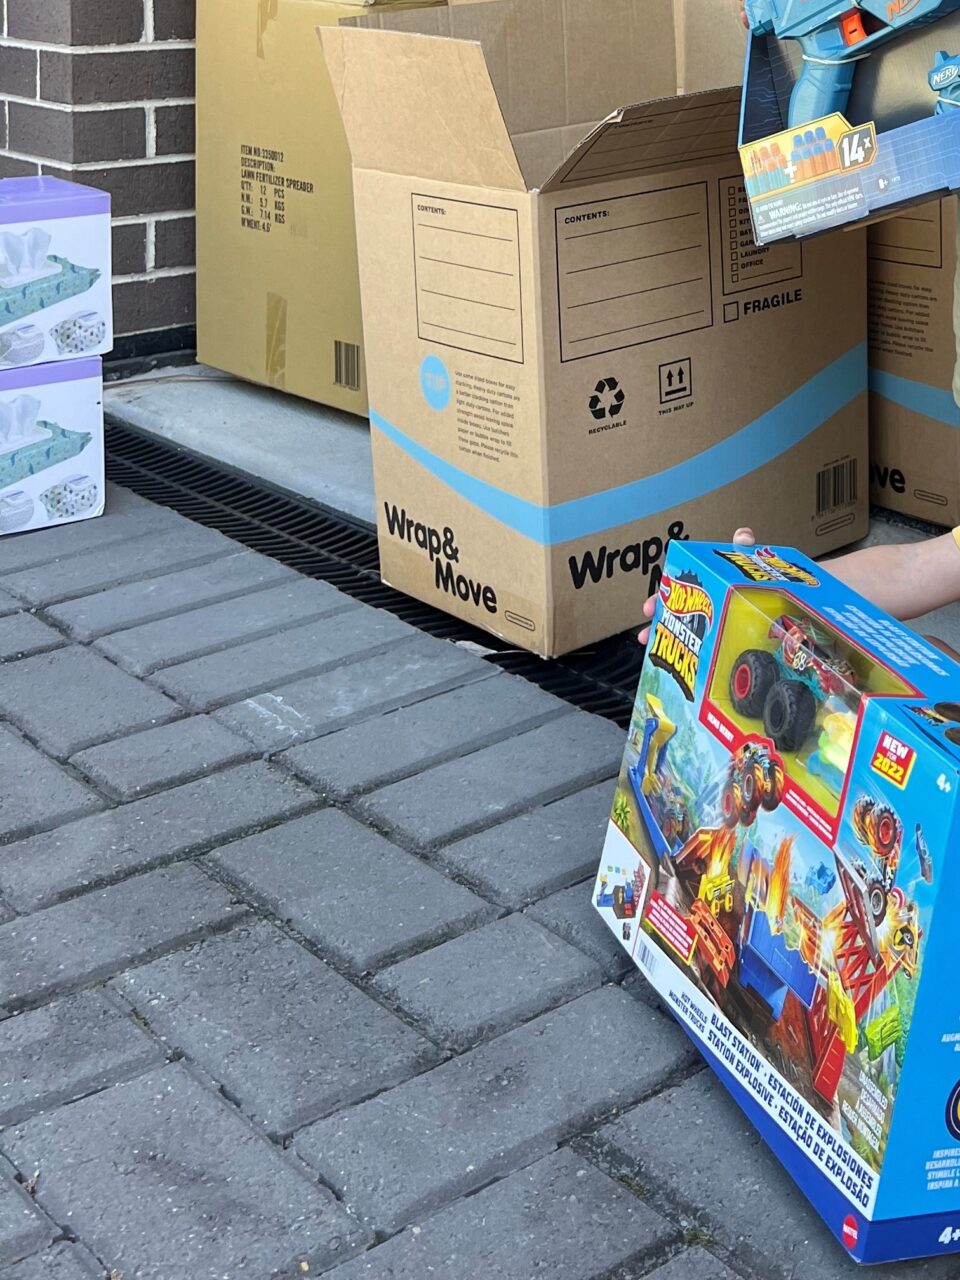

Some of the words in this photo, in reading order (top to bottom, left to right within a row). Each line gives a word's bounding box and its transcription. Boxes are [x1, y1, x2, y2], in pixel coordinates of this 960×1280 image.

[931, 63, 959, 86] NERF
[240, 144, 253, 156] ITEM
[240, 156, 276, 173] DESCRIPTION:
[241, 168, 255, 181] LAWN
[285, 177, 314, 194] SPREADER
[260, 184, 267, 196] 12
[273, 188, 285, 199] PCS
[260, 208, 271, 221] 7.14
[274, 213, 286, 225] KGS
[274, 200, 285, 212] KGS
[416, 203, 447, 216] CONTENTS:
[563, 209, 610, 225] CONTENTS:
[740, 246, 770, 259] LAUNDRY
[740, 258, 764, 270] OFFICE
[743, 288, 803, 316] FRAGILE
[658, 407, 673, 416] THIS
[673, 403, 685, 413] WAY
[588, 419, 628, 435] RECYCLABLE
[435, 557, 498, 614] Move
[665, 580, 687, 611] HOT
[685, 585, 713, 619] WHEELS
[660, 607, 703, 657] MONSTER
[650, 620, 699, 695] TRUCKS
[882, 733, 909, 760] NEW
[873, 752, 905, 782] 2022
[936, 772, 952, 794] 4+
[668, 989, 690, 1017] MONSTER
[687, 1010, 705, 1034] TRUCKS
[680, 991, 691, 1005] HOT
[689, 1002, 709, 1024] WHEELS
[710, 1012, 734, 1042] BLAST
[767, 1072, 806, 1119] ESTACIÓN
[804, 1109, 818, 1132] DE
[816, 1122, 875, 1191] EXPLOSIONES
[707, 1029, 736, 1068] STATION
[735, 1059, 775, 1109] EXPLOSIVE
[778, 1105, 814, 1149] ESTAÇÃO
[813, 1140, 827, 1163] DE
[825, 1152, 870, 1209] EXPLOSÃO
[926, 1168, 957, 1180] STIMULE
[926, 1178, 954, 1191] INSPIRA
